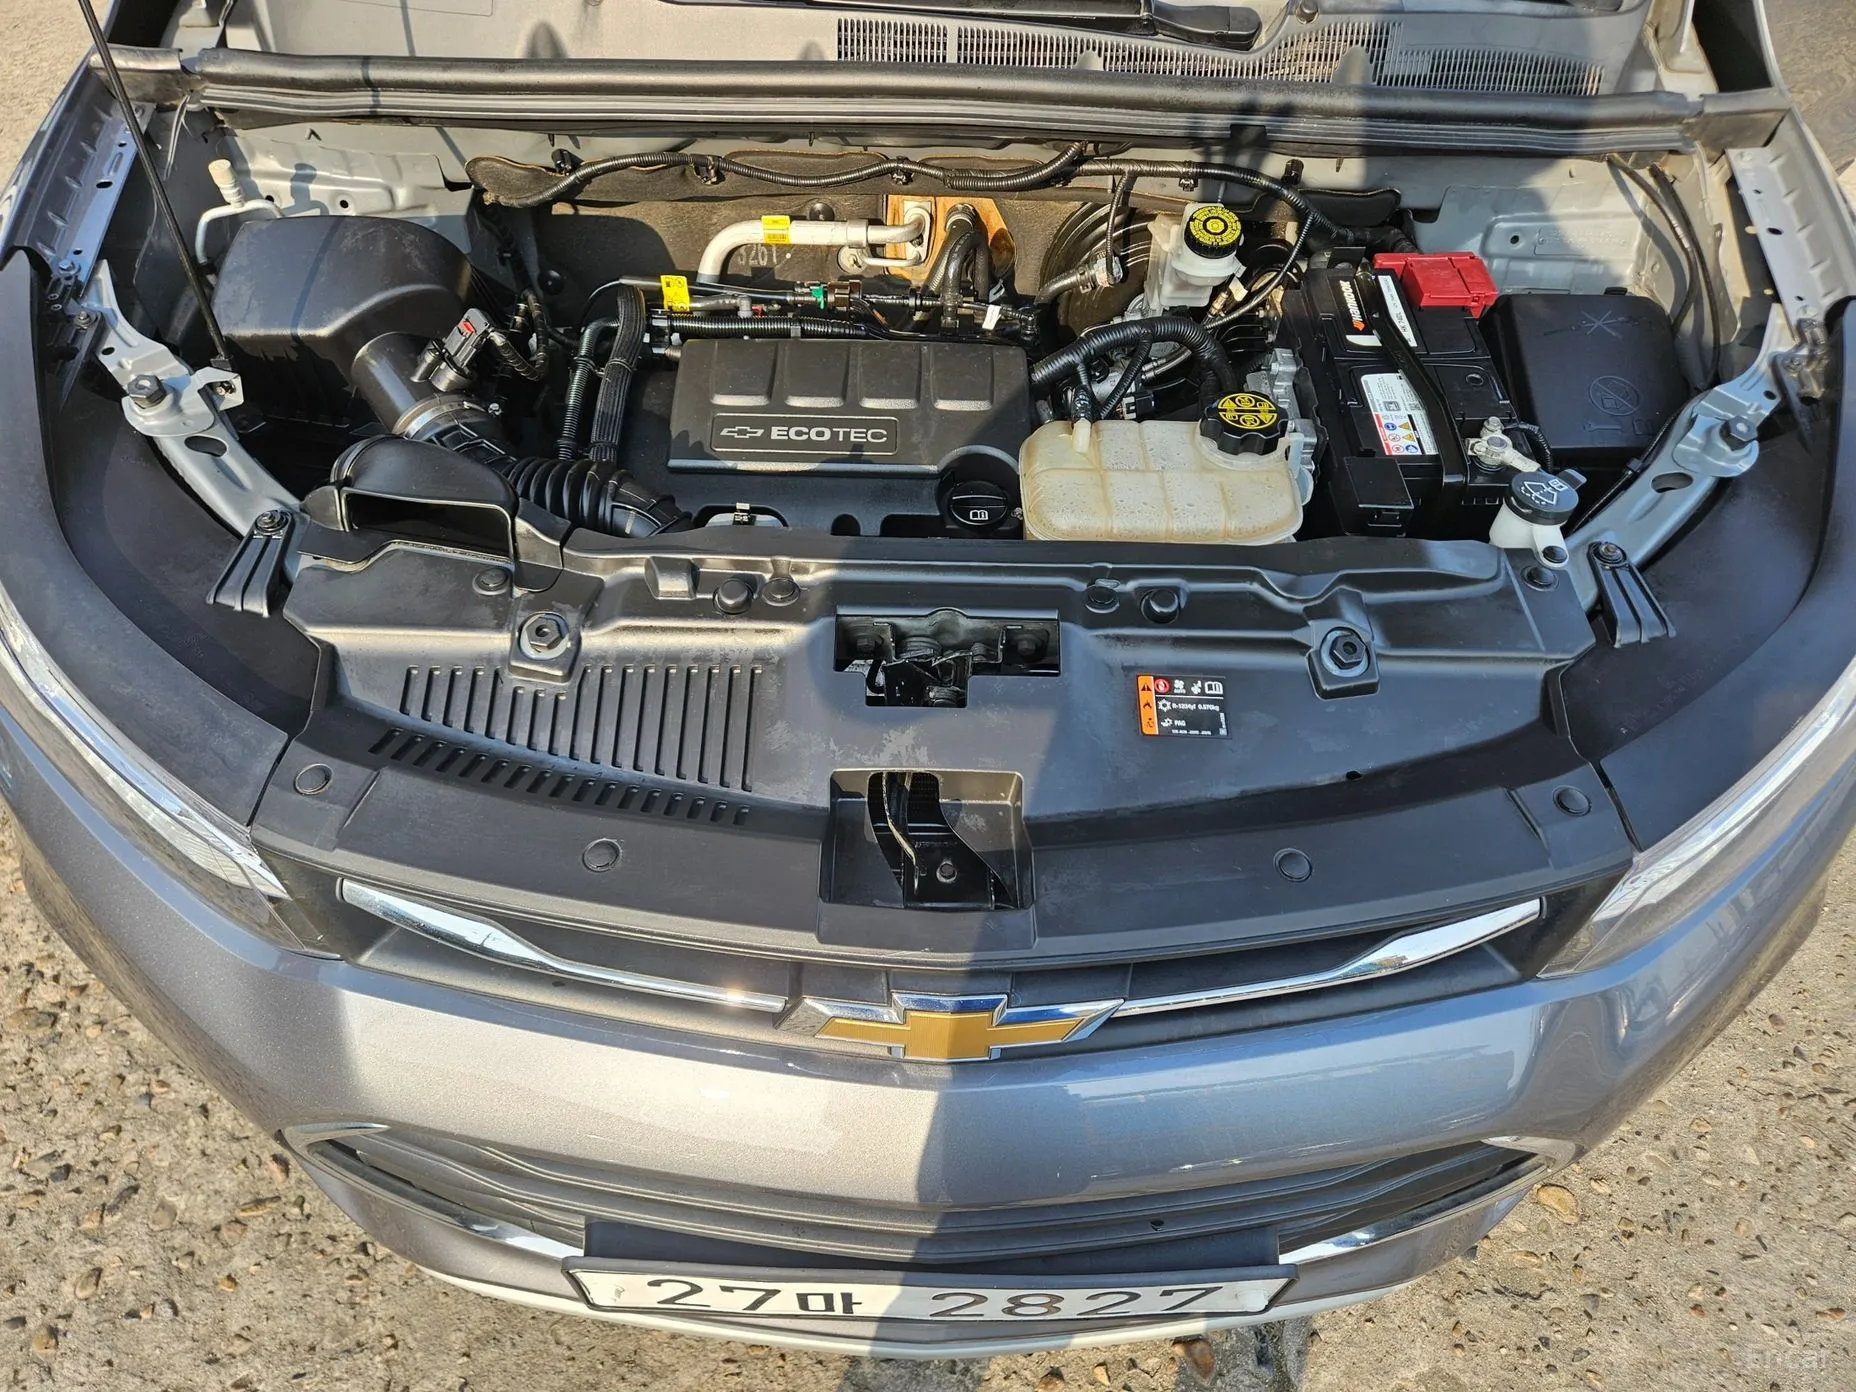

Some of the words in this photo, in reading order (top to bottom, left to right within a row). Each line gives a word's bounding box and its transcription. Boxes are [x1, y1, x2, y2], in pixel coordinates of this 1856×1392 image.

[770, 426, 888, 443] ECOTEC
[1174, 719, 1186, 727] PAG
[647, 1278, 863, 1315] 27마
[929, 1285, 1224, 1318] 2827
